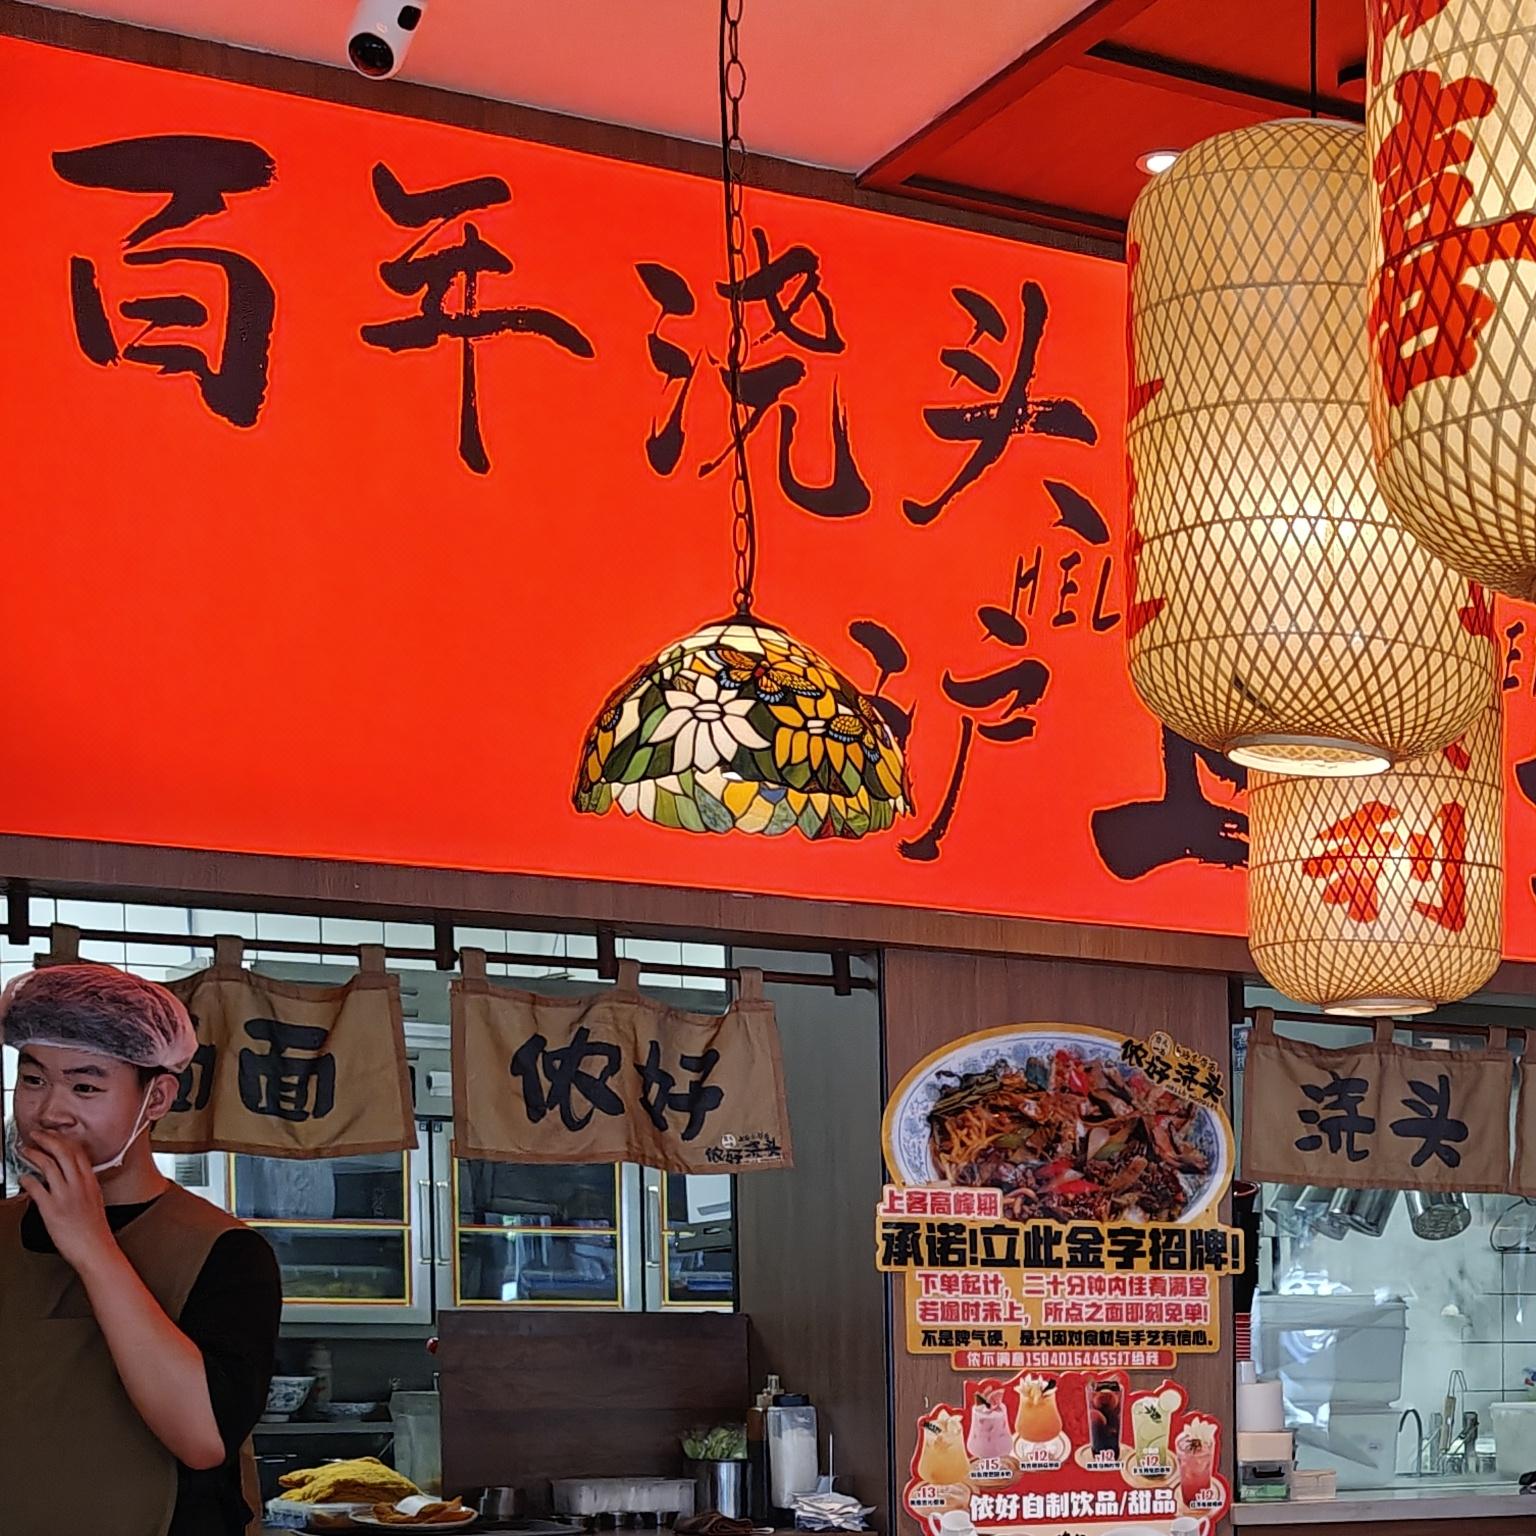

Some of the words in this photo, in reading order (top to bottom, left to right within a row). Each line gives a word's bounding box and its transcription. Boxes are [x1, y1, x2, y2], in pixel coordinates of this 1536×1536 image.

[51, 134, 1110, 545] 百年浇头
[1010, 545, 1121, 632] HEL
[1302, 736, 1471, 932] 利
[510, 1027, 724, 1141] 侬好
[1121, 1039, 1225, 1103] 侬好浇头
[1295, 1070, 1470, 1168] 浇头
[882, 1190, 998, 1217] 上客高峰期
[970, 1488, 1176, 1521] 侬好自制饮品/甜品
